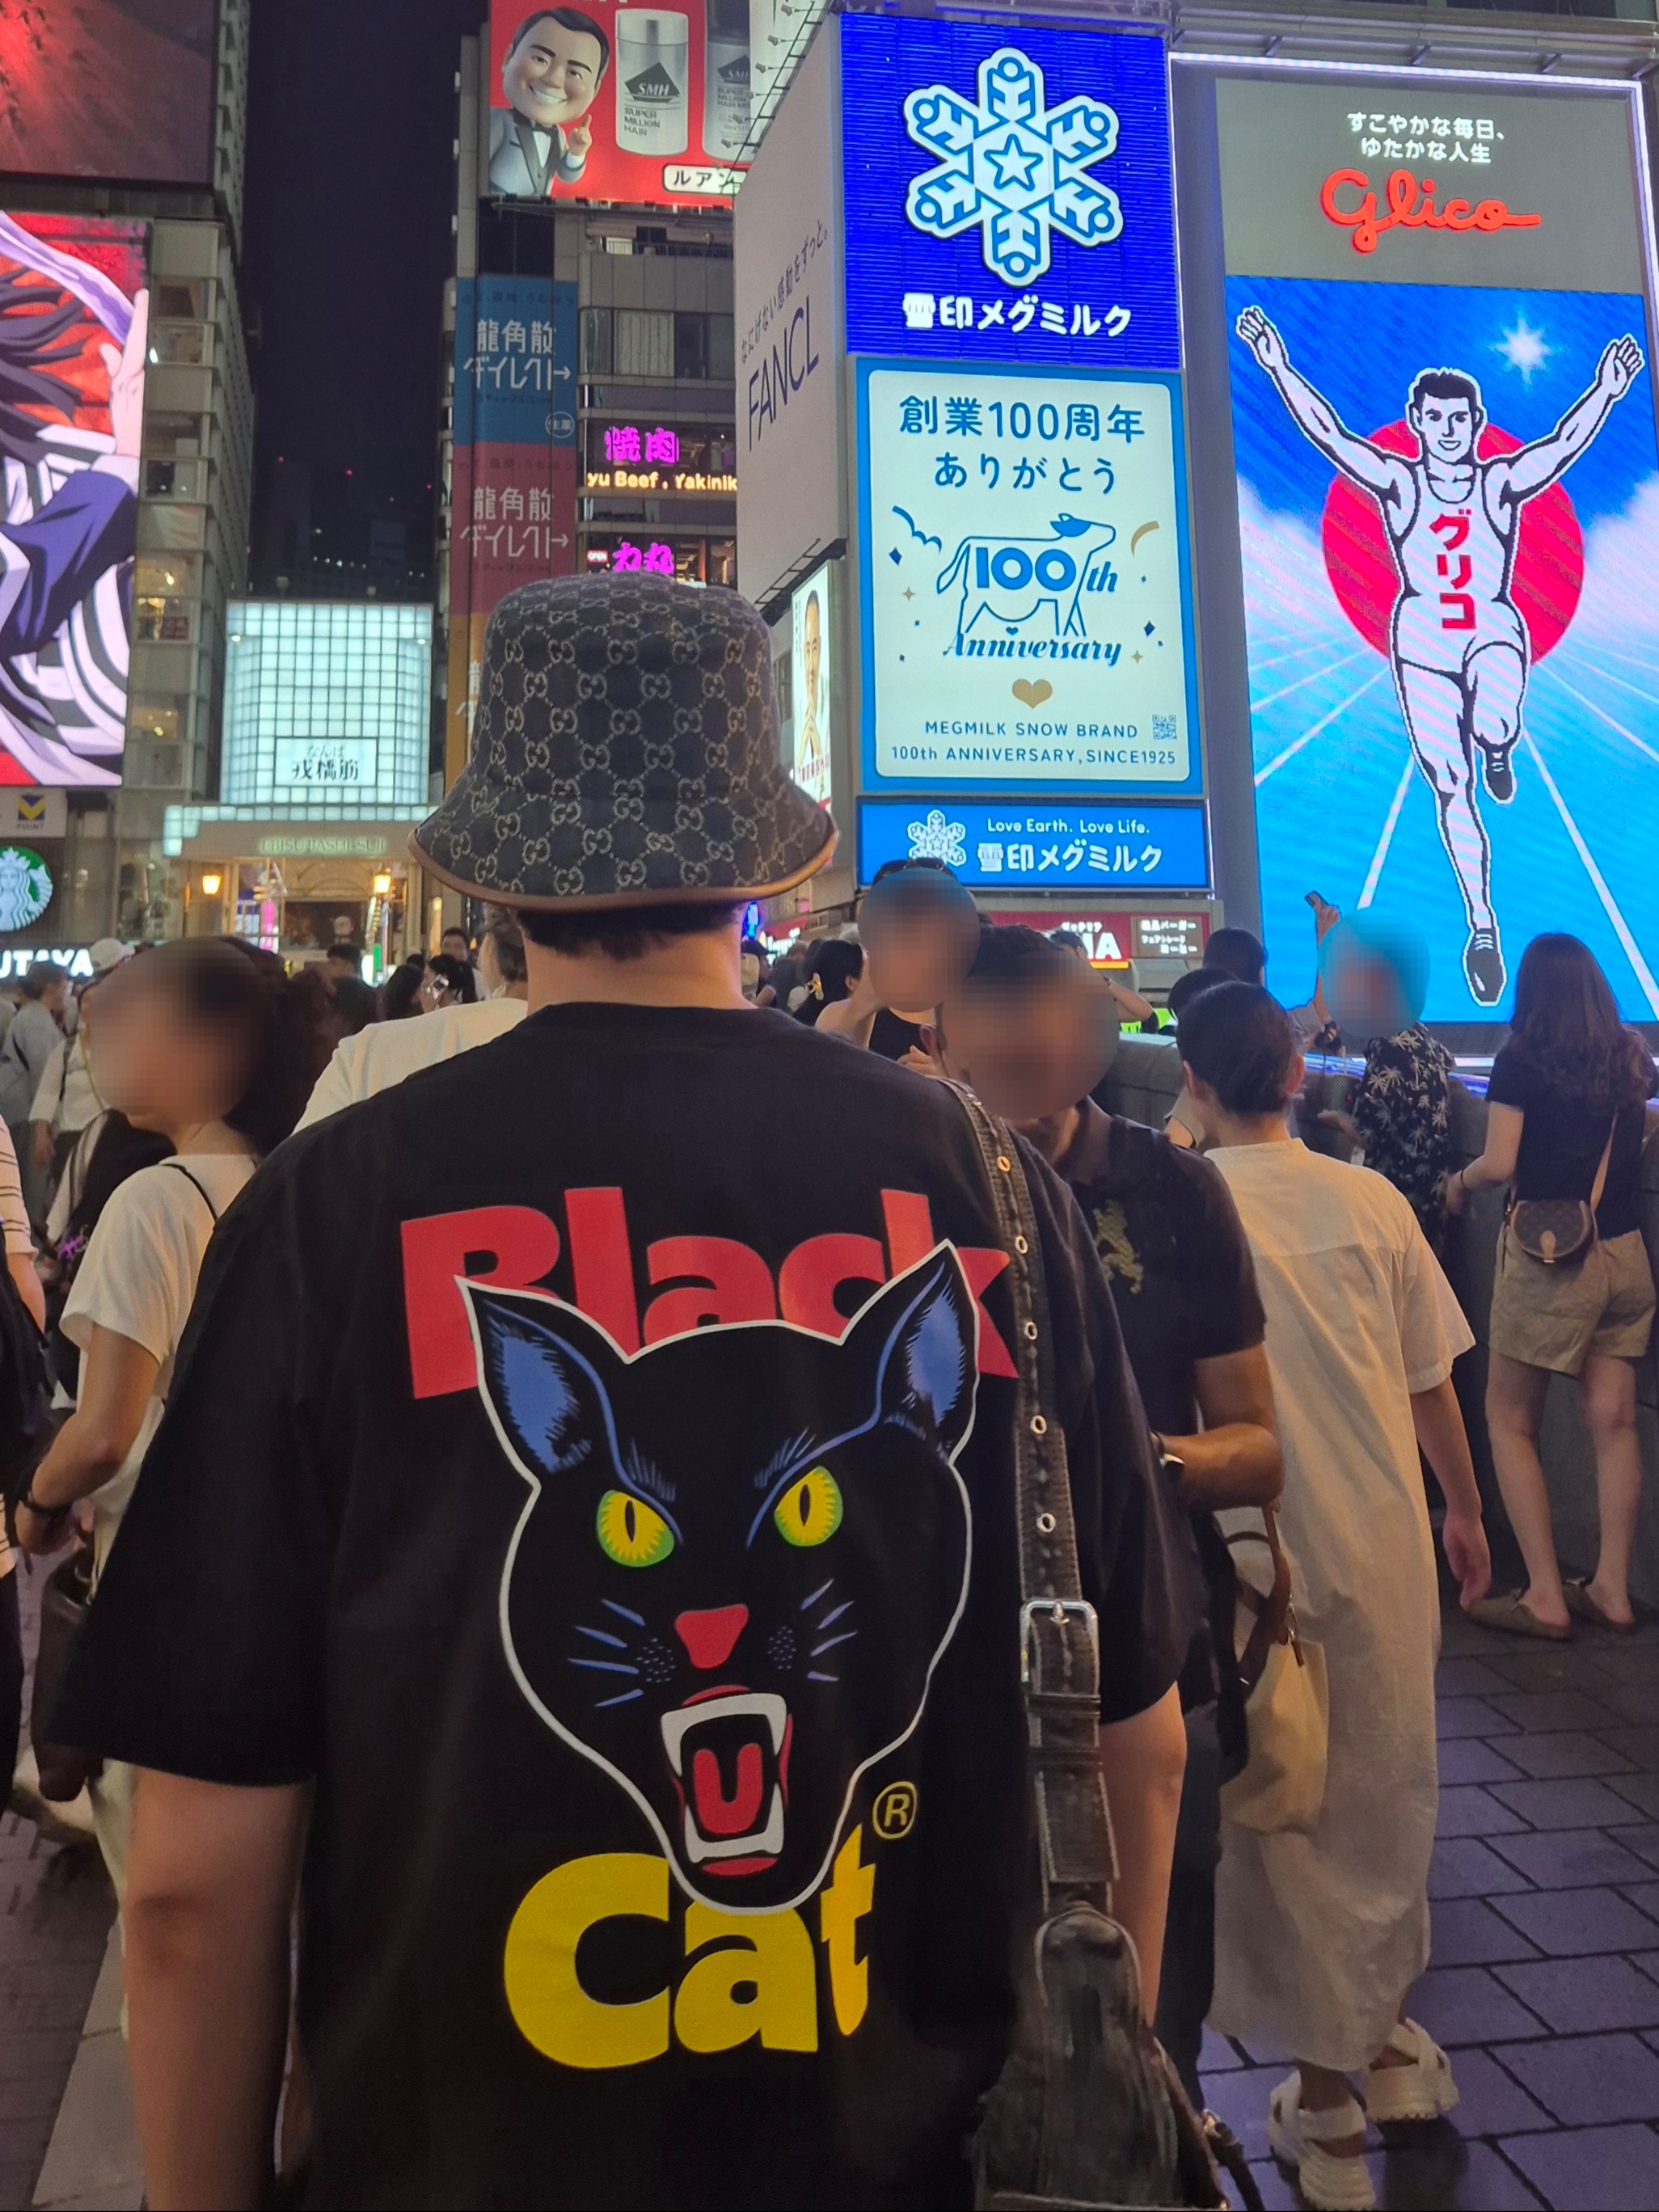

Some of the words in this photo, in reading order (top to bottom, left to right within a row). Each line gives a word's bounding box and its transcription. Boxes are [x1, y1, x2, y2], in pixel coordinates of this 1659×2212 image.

[638, 82, 670, 96] SMH
[624, 107, 657, 119] SUPER
[624, 116, 661, 129] MILLION
[1347, 112, 1505, 141] すこやかな毎日、
[624, 125, 648, 136] HAIR
[1361, 137, 1491, 164] ゆたかな人生
[1320, 167, 1542, 253] Glico
[902, 292, 1132, 338] 雪印メグミルク
[477, 319, 557, 356] 龍角散
[463, 356, 572, 391] ダイレクト
[748, 294, 820, 453] FANCL
[899, 395, 1146, 444] 創業100周年
[605, 426, 680, 464] 焼肉
[935, 452, 1116, 495] ありがとう
[474, 486, 555, 521] 龍角散
[1429, 508, 1476, 631] グリコ
[943, 632, 1122, 666] Anniversary
[925, 721, 1007, 736] MEGMILK
[1015, 724, 1068, 737] SNOW
[1077, 724, 1138, 738] BRAND
[307, 744, 345, 758] なんば
[891, 746, 938, 761] 100th
[292, 758, 359, 781] 戎橋筋
[987, 817, 1022, 833] Love
[1026, 818, 1073, 834] Earth.
[1079, 819, 1114, 834] Love
[1118, 819, 1150, 834] Life.
[977, 838, 1162, 872] 雪印メグミルク
[399, 1185, 1019, 1399] Black
[503, 1824, 876, 2071] Cat
